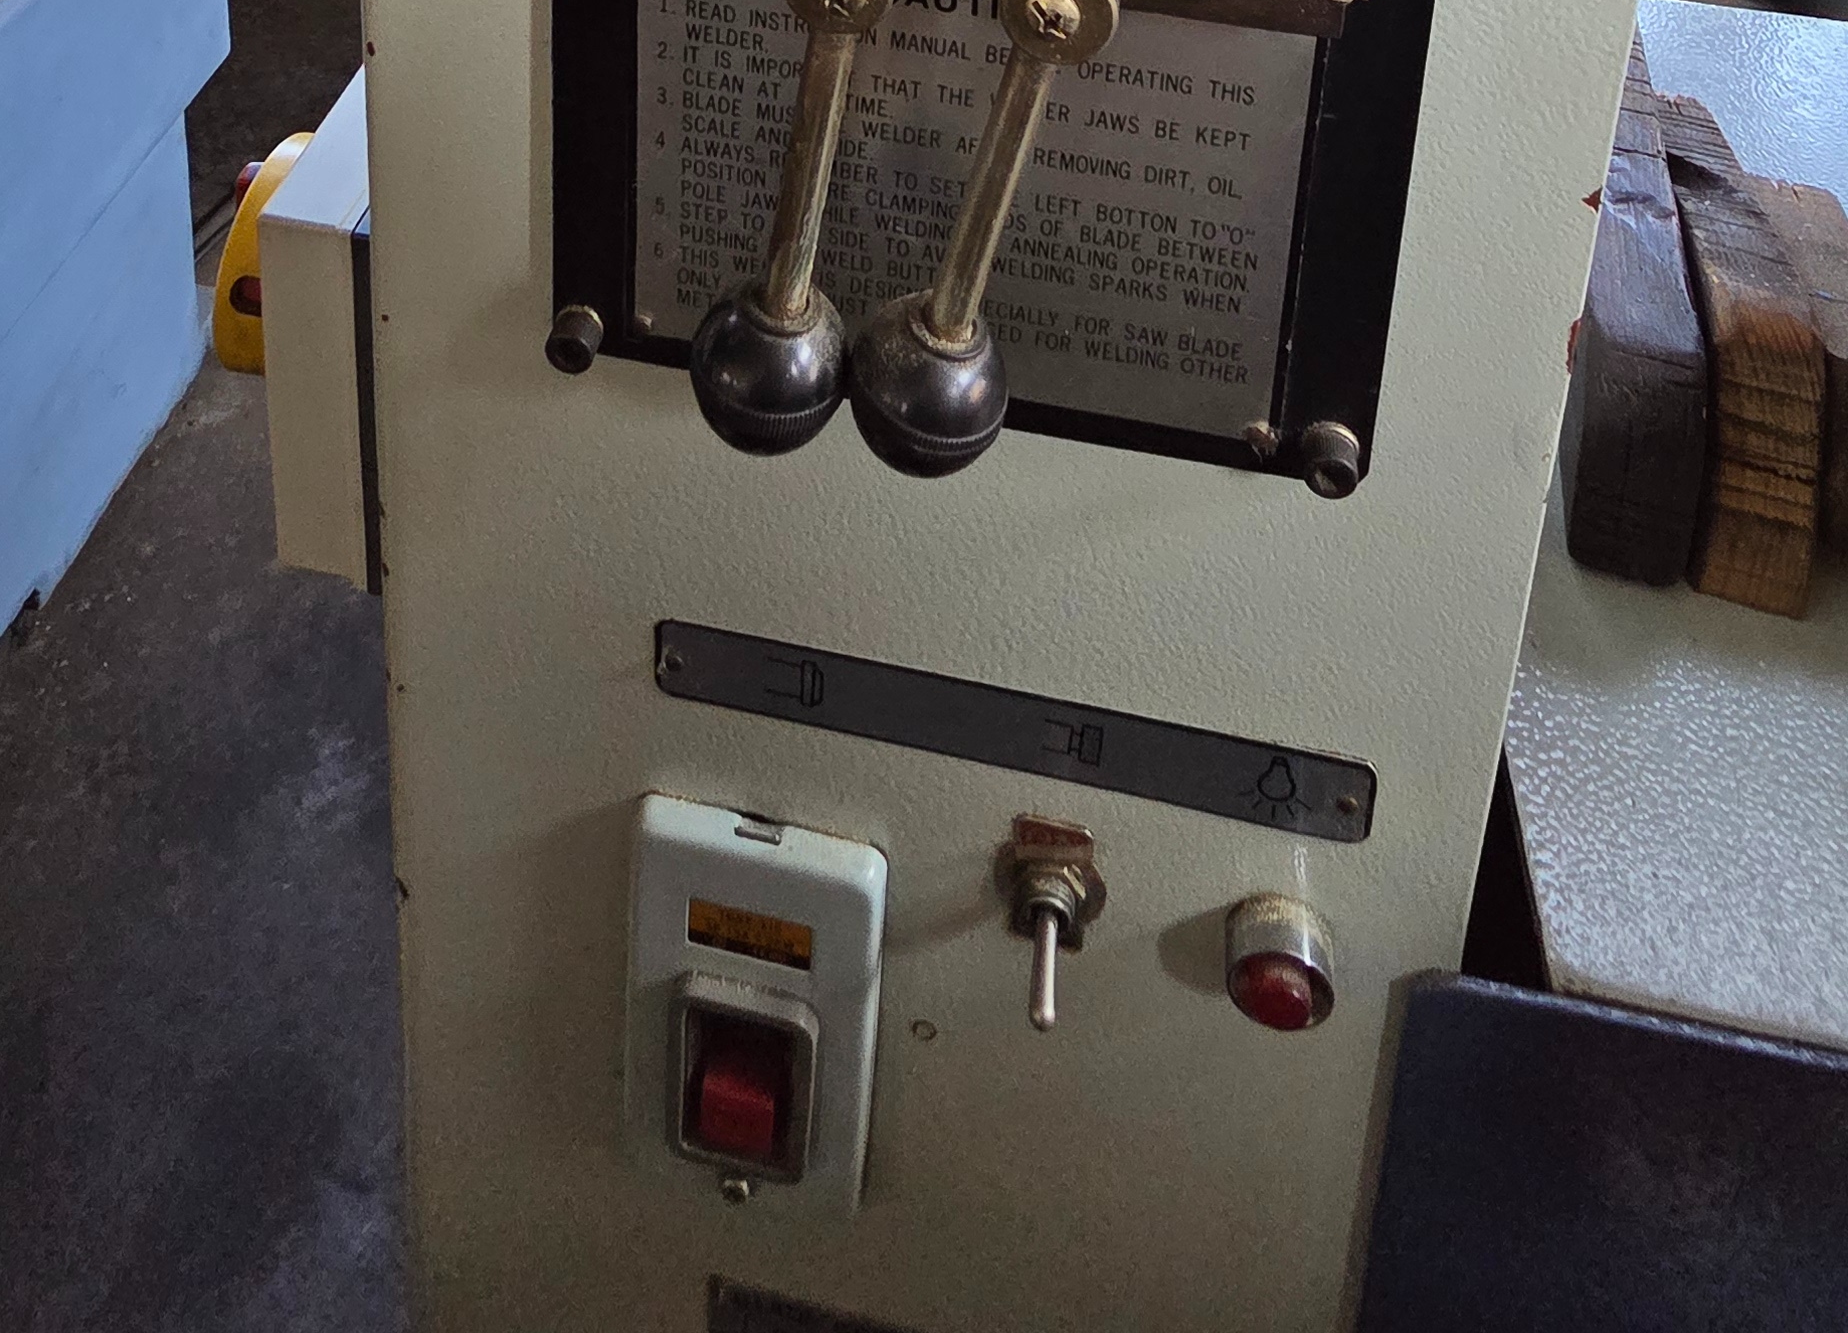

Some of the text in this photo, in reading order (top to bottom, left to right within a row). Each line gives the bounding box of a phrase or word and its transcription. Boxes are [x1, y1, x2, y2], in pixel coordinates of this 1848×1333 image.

[682, 67, 745, 94] CLEAN
[757, 81, 782, 100] AT
[683, 46, 701, 64] IT
[715, 50, 732, 69] IS
[871, 74, 922, 100] THAT
[937, 83, 976, 109] THE
[1084, 109, 1140, 135] JAWS
[1154, 119, 1181, 142] BE
[1195, 125, 1252, 152] KEPT
[891, 30, 971, 62] MANUAL
[1077, 59, 1193, 95] OPERATING
[1209, 79, 1256, 106] THIS
[682, 114, 741, 140] SCALE
[682, 90, 742, 117] BLADE
[862, 119, 942, 149] WELDER
[1033, 147, 1132, 181] REMOVING
[680, 136, 756, 164] ALWAYS
[894, 170, 919, 192] TO
[929, 176, 966, 199] SET
[1035, 193, 1082, 218] LEFT
[1096, 202, 1178, 235] BOTTON
[681, 158, 767, 187] POSITION
[1040, 218, 1064, 239] OF
[1080, 225, 1142, 253] BLADE
[1157, 237, 1259, 272] BETWEEN
[681, 179, 726, 204] POLE
[1010, 236, 1119, 272] ANNEALING
[679, 224, 759, 254] PUSHING
[821, 248, 874, 274] WELD
[679, 201, 729, 225] STEP
[741, 211, 766, 233] TO
[828, 227, 871, 252] SIDE
[885, 236, 911, 257] TO
[990, 256, 1076, 287] WELDING
[1089, 271, 1169, 303] SPARKS
[1182, 288, 1242, 316] WHEN
[679, 245, 720, 270] THIS
[1074, 312, 1112, 338] FOR
[1124, 322, 1170, 348] SAW
[1177, 334, 1244, 363] BLADE
[1034, 331, 1073, 354] FOR
[1083, 338, 1171, 372] WELDING
[1180, 355, 1250, 386] OTHER
